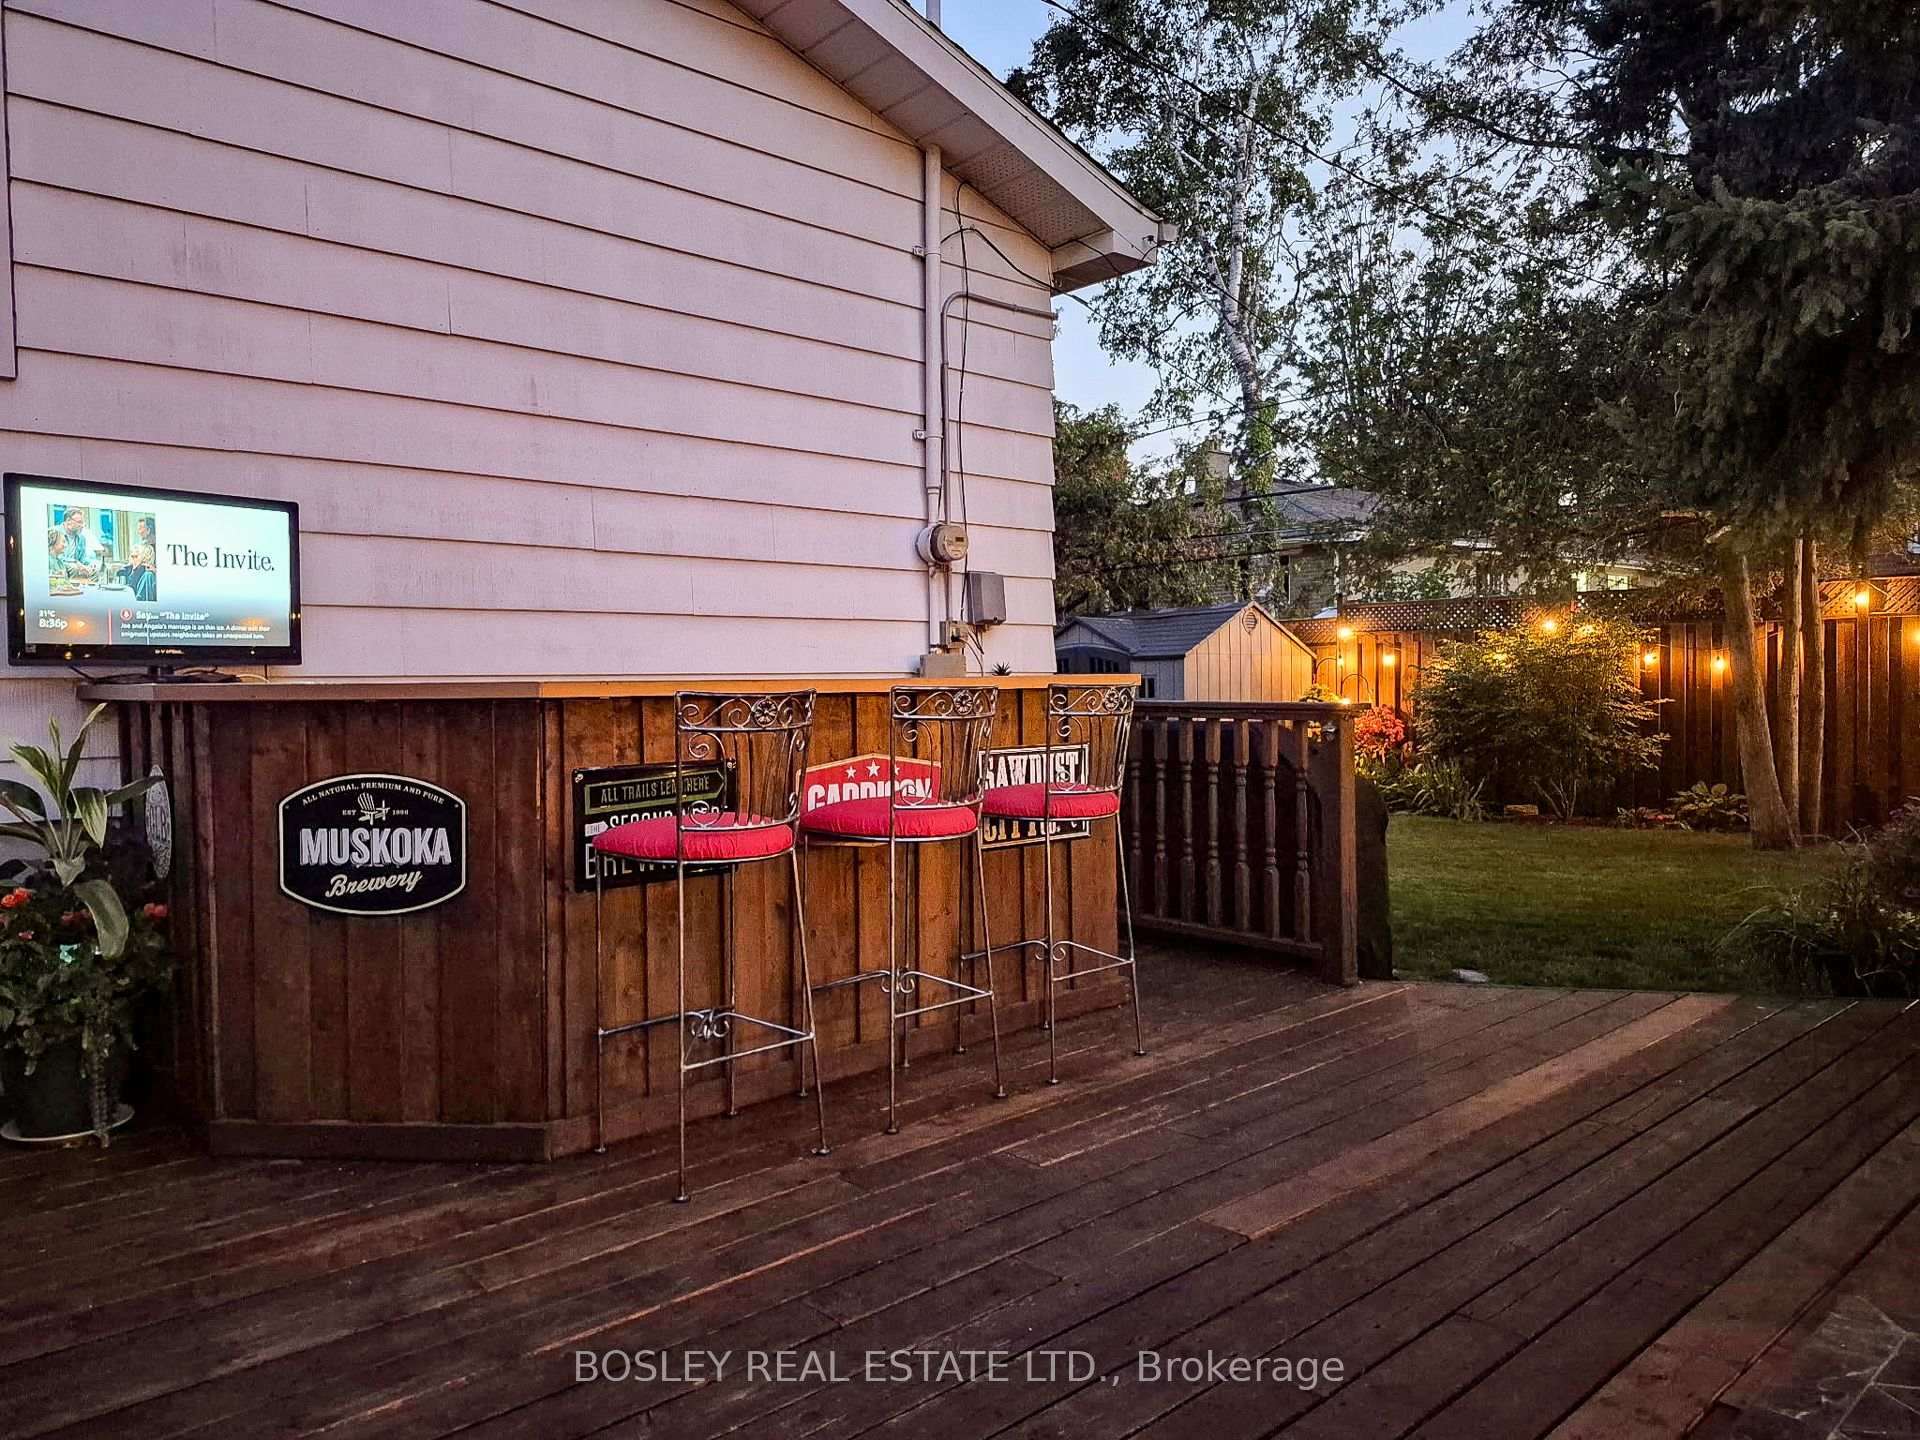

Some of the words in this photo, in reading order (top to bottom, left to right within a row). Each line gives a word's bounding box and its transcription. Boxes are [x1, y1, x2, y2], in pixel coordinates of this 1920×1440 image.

[167, 543, 208, 568] The
[215, 546, 275, 572] Invite.
[39, 618, 68, 630] 8:36p
[302, 794, 318, 806] ALL
[361, 782, 401, 791] PREMIUM
[403, 785, 422, 796] AND
[422, 790, 445, 805] PURE
[601, 788, 618, 804] ALL
[621, 784, 657, 801] TRAILS
[660, 778, 678, 796] LEA
[299, 827, 452, 867] MUSKOKA
[324, 870, 423, 898] Brewery
